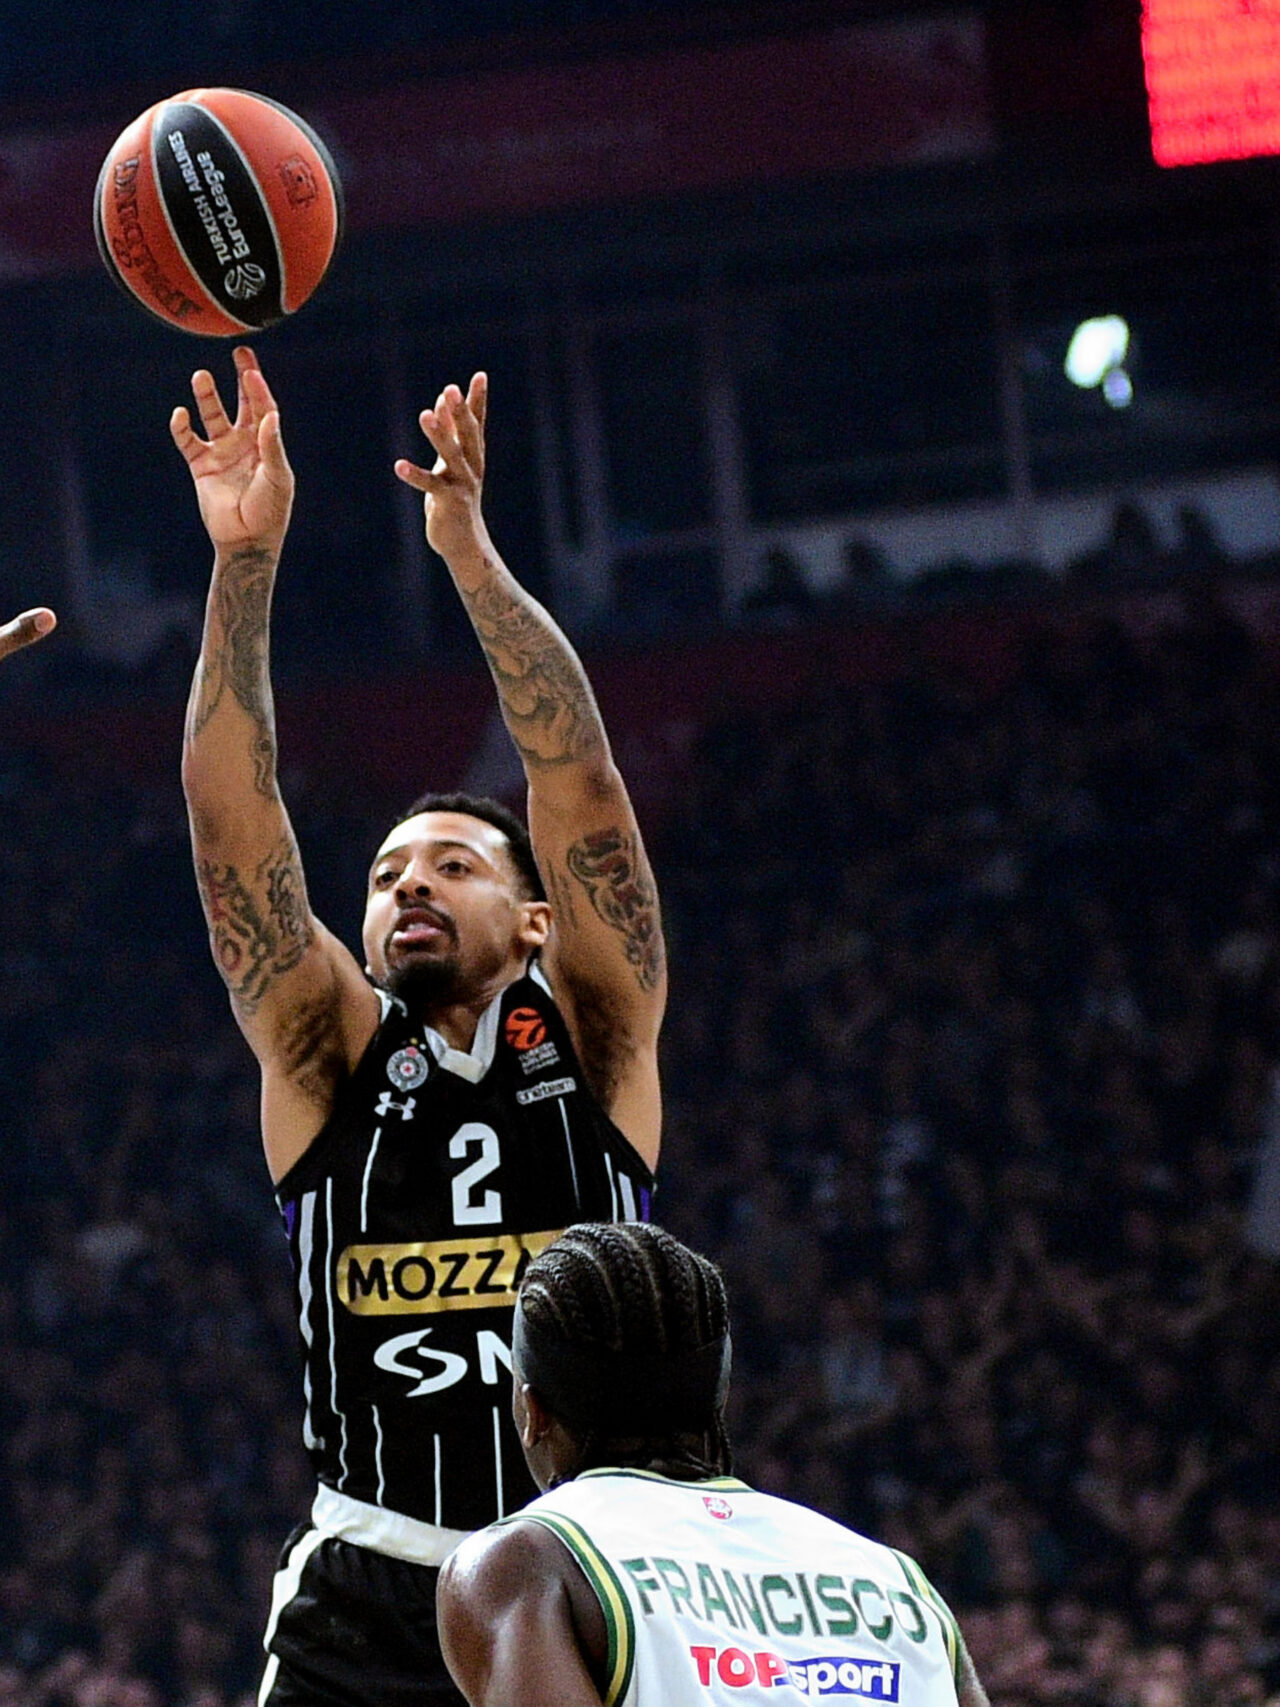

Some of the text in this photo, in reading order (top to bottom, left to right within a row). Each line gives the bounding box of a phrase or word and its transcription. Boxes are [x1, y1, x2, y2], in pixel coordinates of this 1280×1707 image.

[168, 129, 232, 266] TURKISH AIRLINES
[197, 151, 250, 259] EuroLeague
[449, 1122, 503, 1227] 2
[620, 1557, 927, 1643] FRANCISCO
